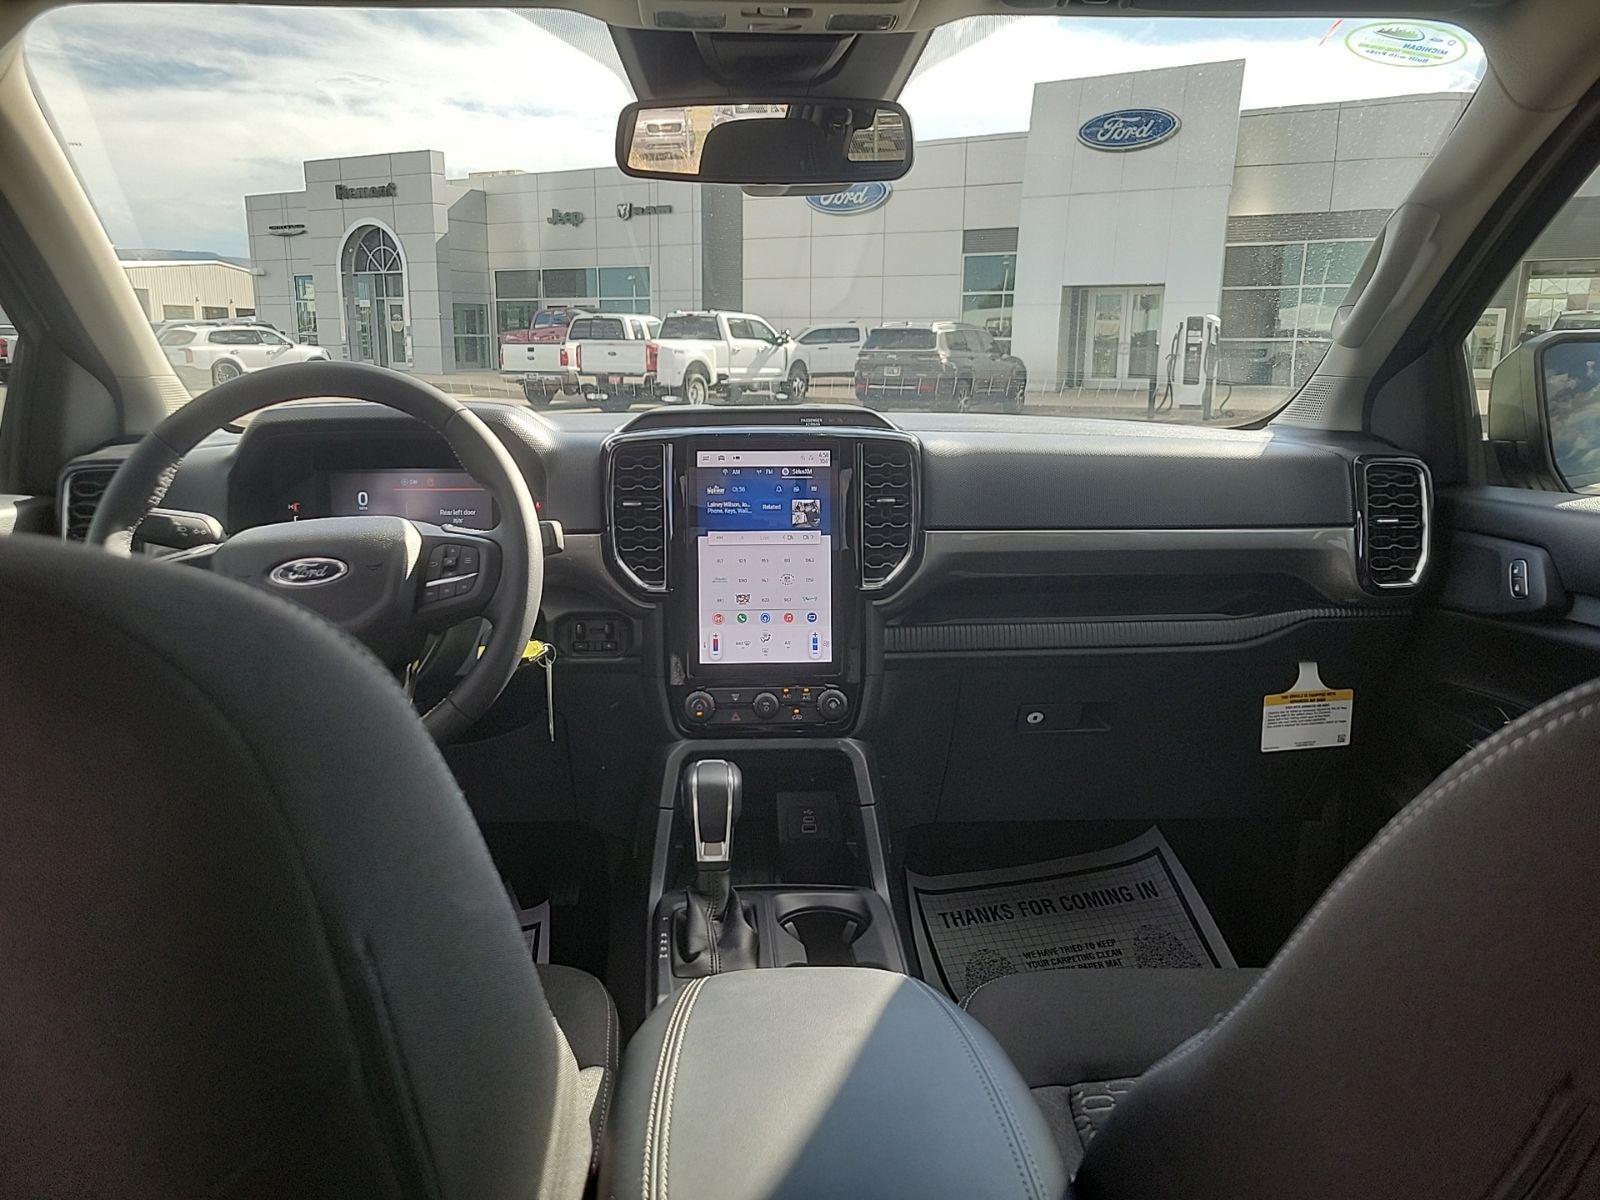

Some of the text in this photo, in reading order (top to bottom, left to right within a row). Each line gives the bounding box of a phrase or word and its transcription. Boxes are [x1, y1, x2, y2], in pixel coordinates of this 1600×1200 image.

[1097, 116, 1154, 141] Ford
[547, 208, 583, 226] Jeep
[358, 492, 368, 506] 0
[288, 563, 328, 579] Ford
[938, 880, 1159, 930] THANKS FOR COMING IN
[1023, 938, 1116, 960] WE HAVE TRIED TO KEEP
[1026, 948, 1122, 970] YOUR CARPETING CLEAN
[1106, 958, 1122, 968] MAT
